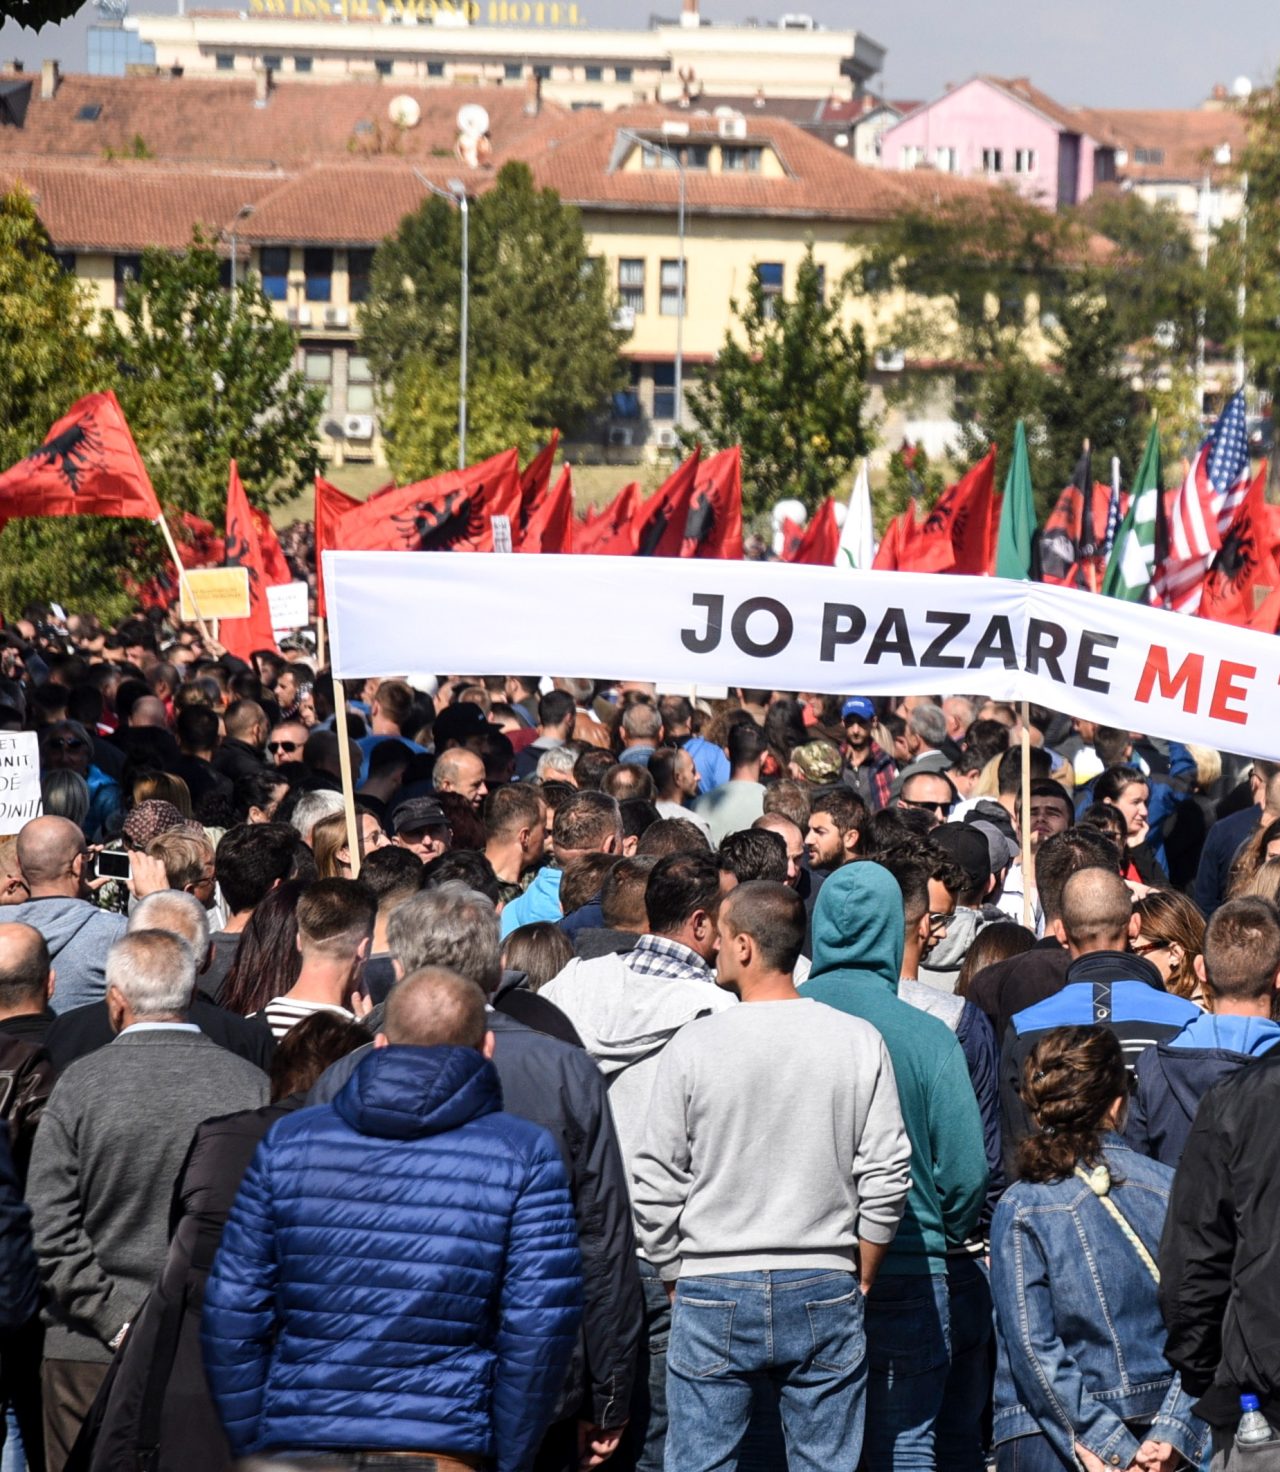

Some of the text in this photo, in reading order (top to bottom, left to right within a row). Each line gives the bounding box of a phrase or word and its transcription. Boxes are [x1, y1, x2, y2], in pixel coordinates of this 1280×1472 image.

[488, 2, 580, 25] HOTEL
[680, 592, 793, 658] JO
[819, 602, 1119, 694] PAZARE
[1134, 644, 1257, 725] ME
